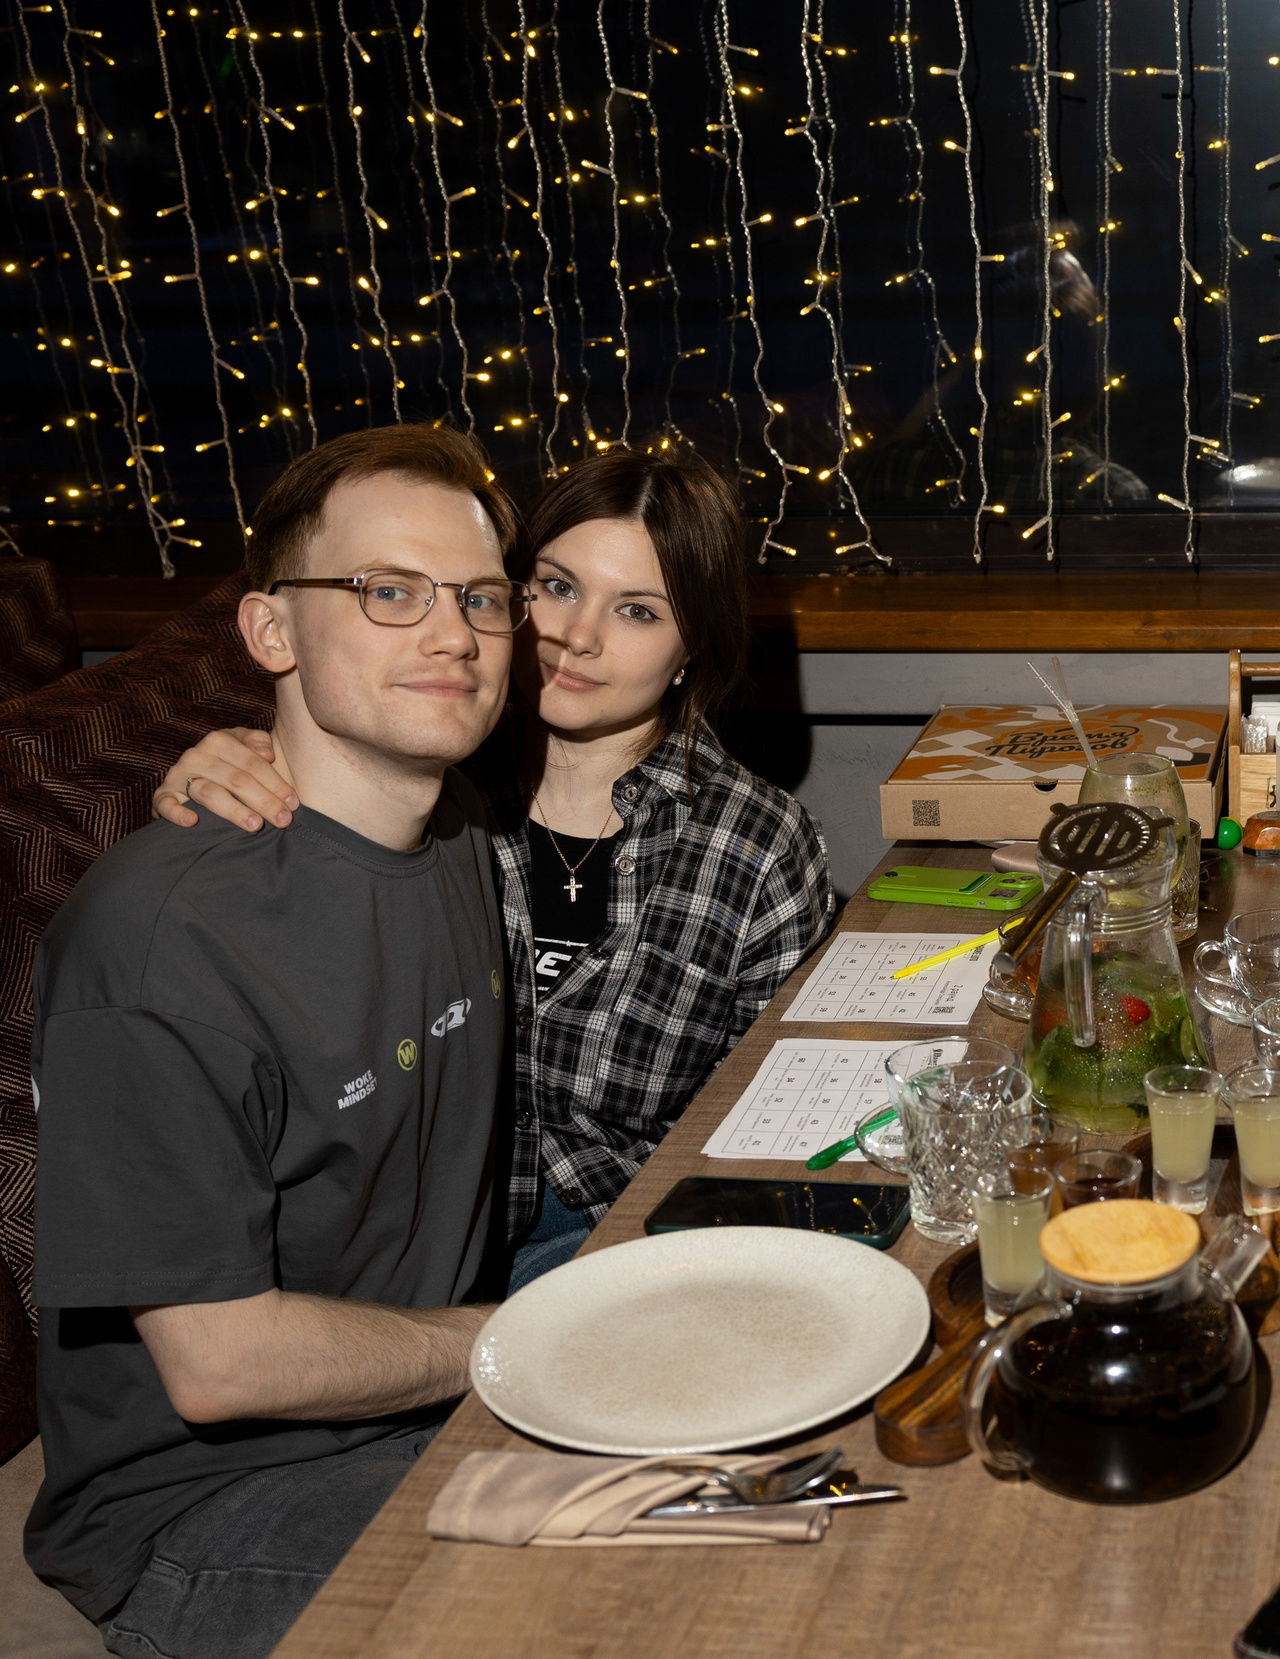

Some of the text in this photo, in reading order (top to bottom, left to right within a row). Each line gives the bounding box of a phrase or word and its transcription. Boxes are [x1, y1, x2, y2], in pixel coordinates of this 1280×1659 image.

[985, 737, 1129, 759] Пирогов
[1009, 725, 1139, 747] Время
[535, 948, 572, 977] E
[399, 1042, 416, 1066] W
[337, 1077, 377, 1110] MINDSET
[344, 1069, 373, 1095] WOKE
